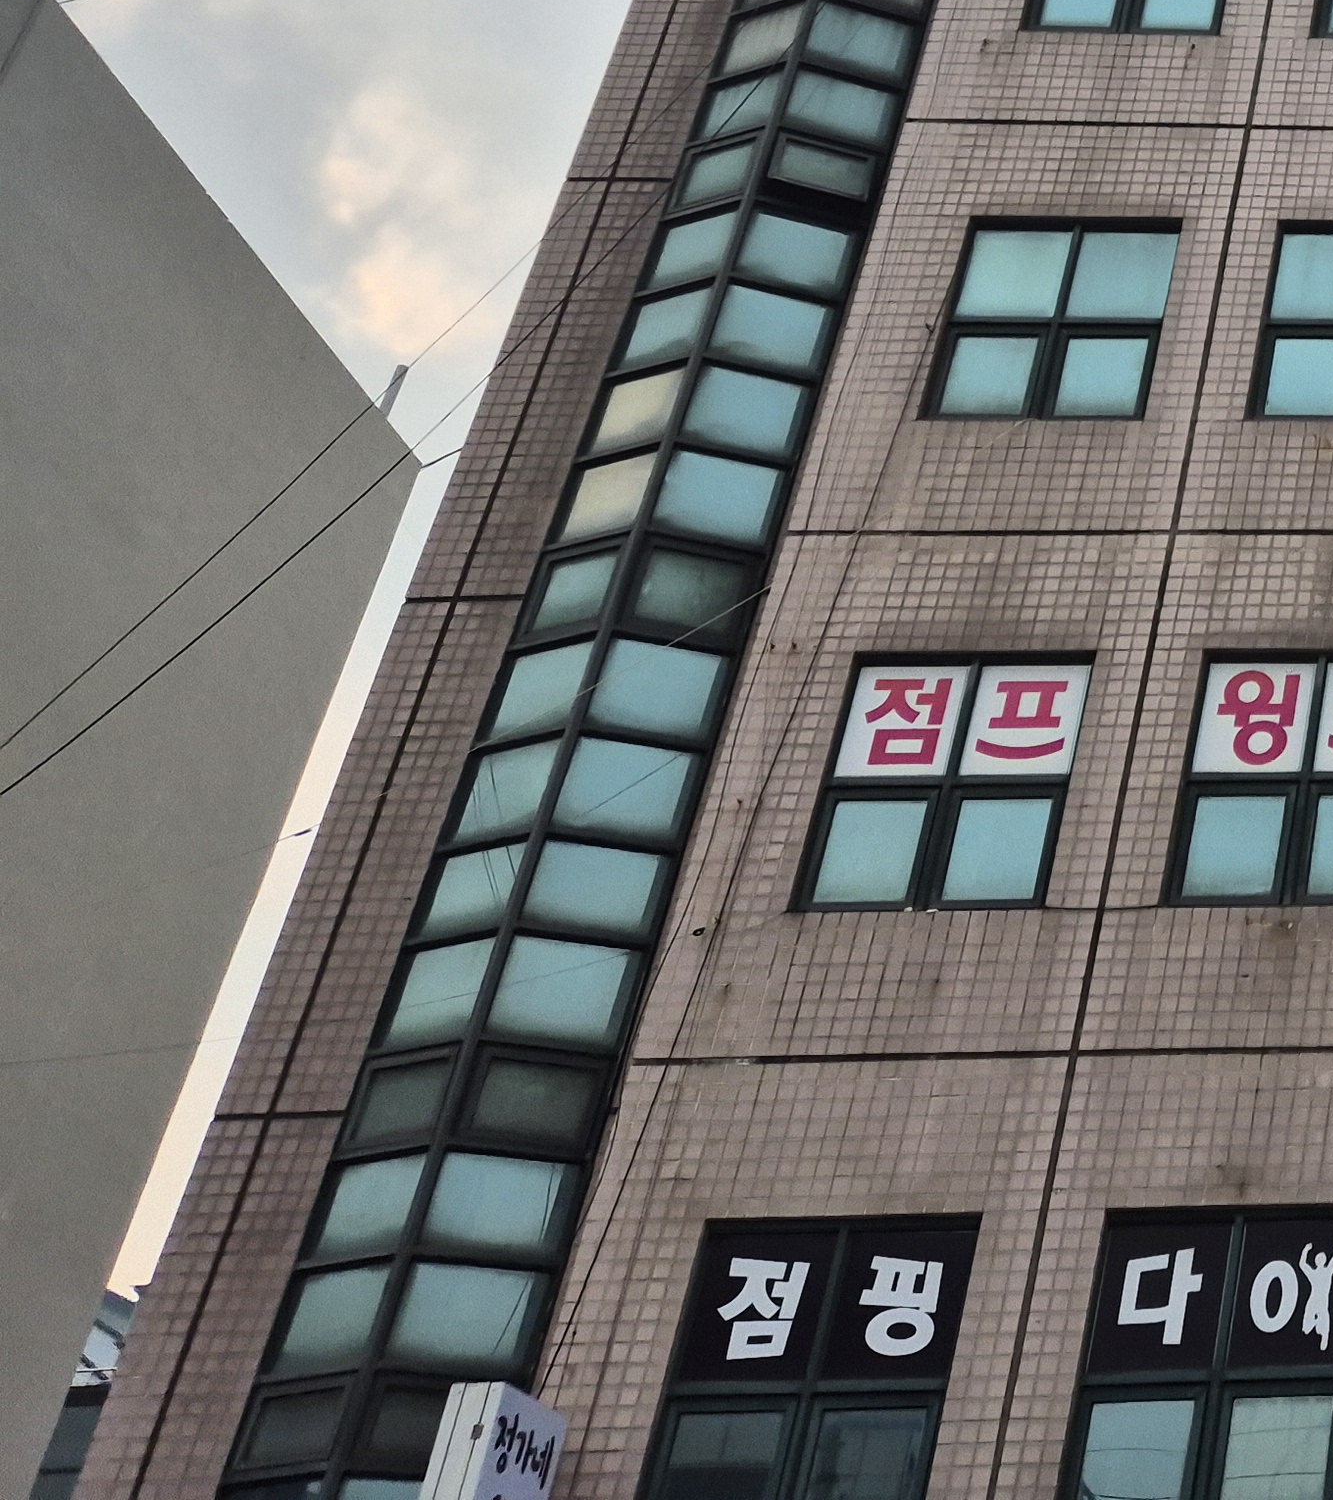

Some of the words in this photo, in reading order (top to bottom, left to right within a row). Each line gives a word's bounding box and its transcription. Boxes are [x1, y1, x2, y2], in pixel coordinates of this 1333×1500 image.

[865, 677, 1068, 765] 점프
[717, 1254, 945, 1361] 점핑
[494, 1412, 555, 1491] 정가네
